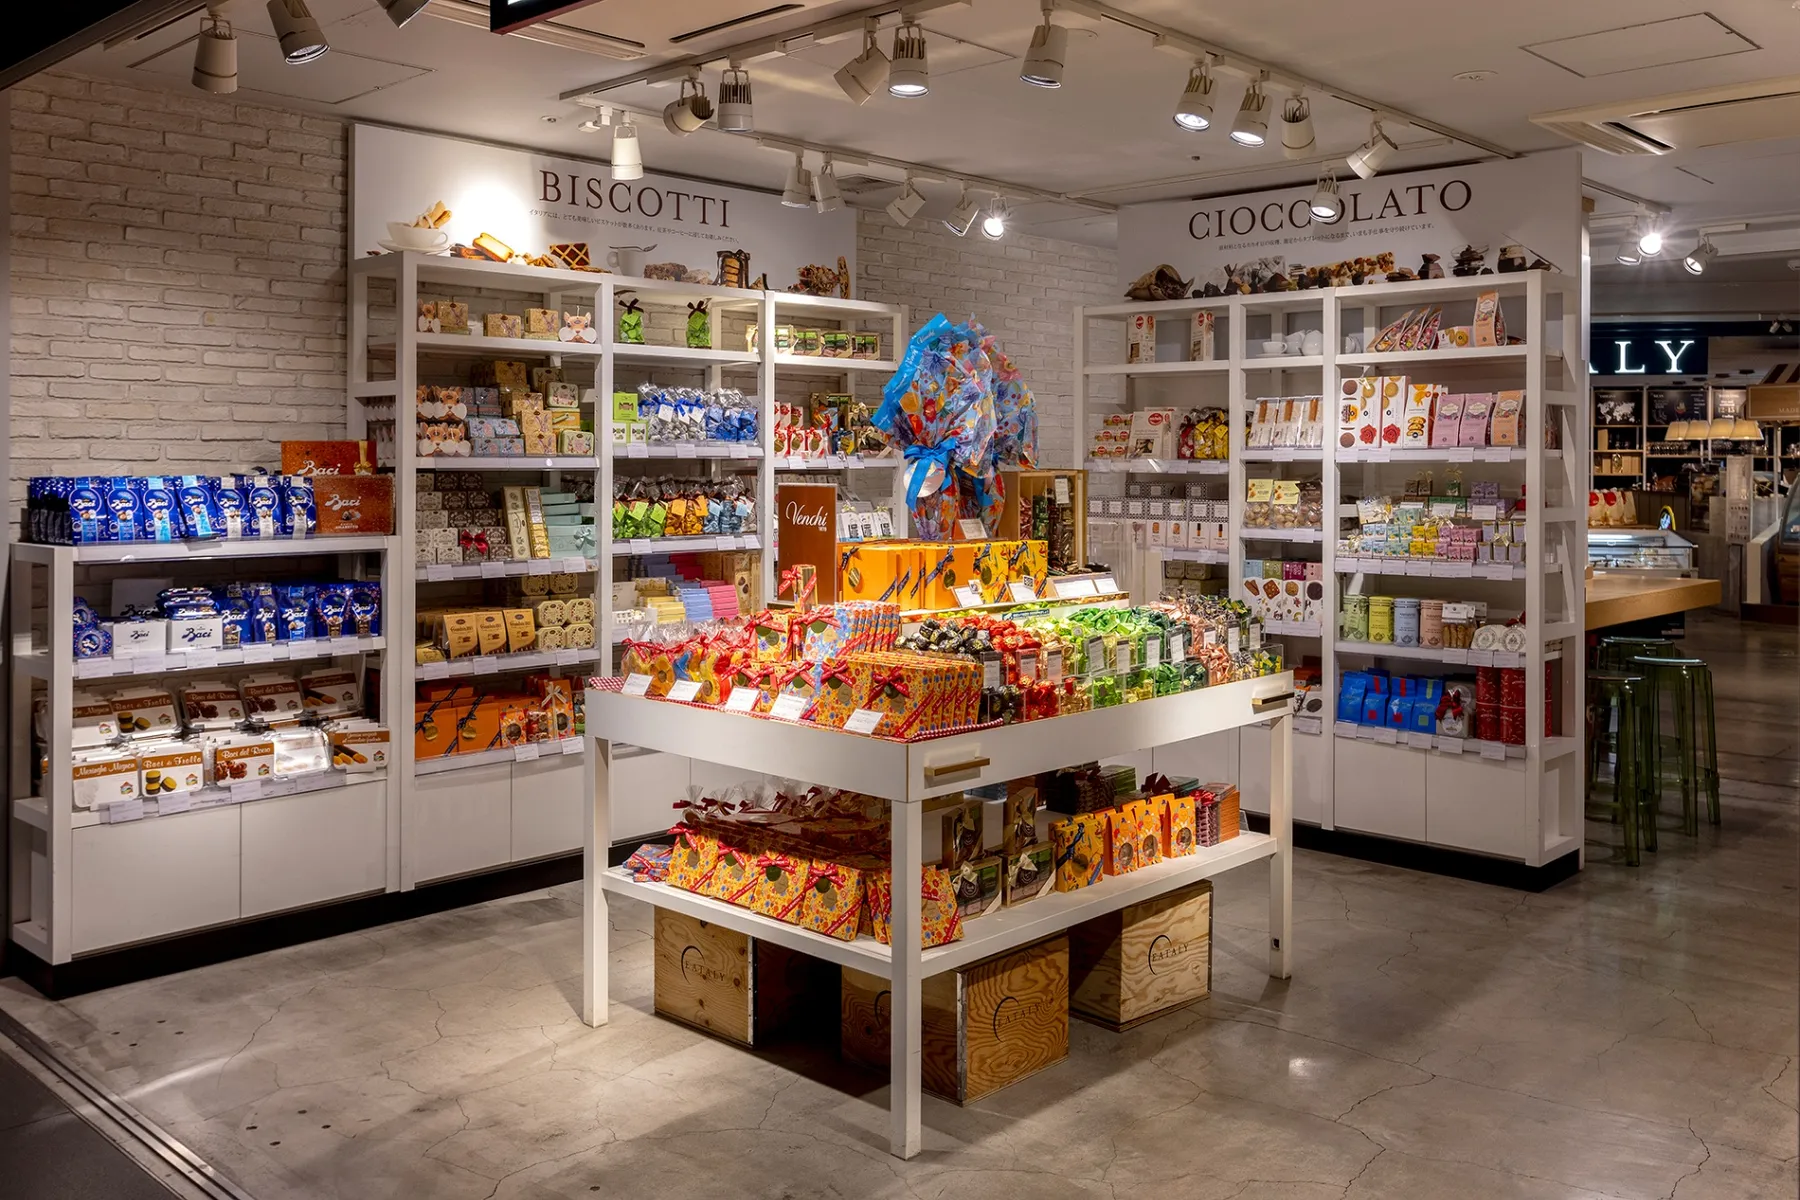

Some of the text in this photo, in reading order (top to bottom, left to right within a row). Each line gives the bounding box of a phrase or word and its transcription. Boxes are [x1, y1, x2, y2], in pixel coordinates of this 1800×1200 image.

[539, 169, 731, 228] BISCOTTI
[1588, 340, 1695, 374] LY
[297, 459, 341, 476] Baci
[325, 494, 362, 511] Baci
[785, 500, 829, 527] Venchi
[221, 609, 248, 623] Baci
[282, 608, 309, 621] Baci
[323, 604, 344, 615] Baci
[130, 630, 150, 640] Baci
[182, 627, 213, 642] Baci
[1152, 942, 1189, 962] EATALY
[685, 960, 725, 982] EATALY
